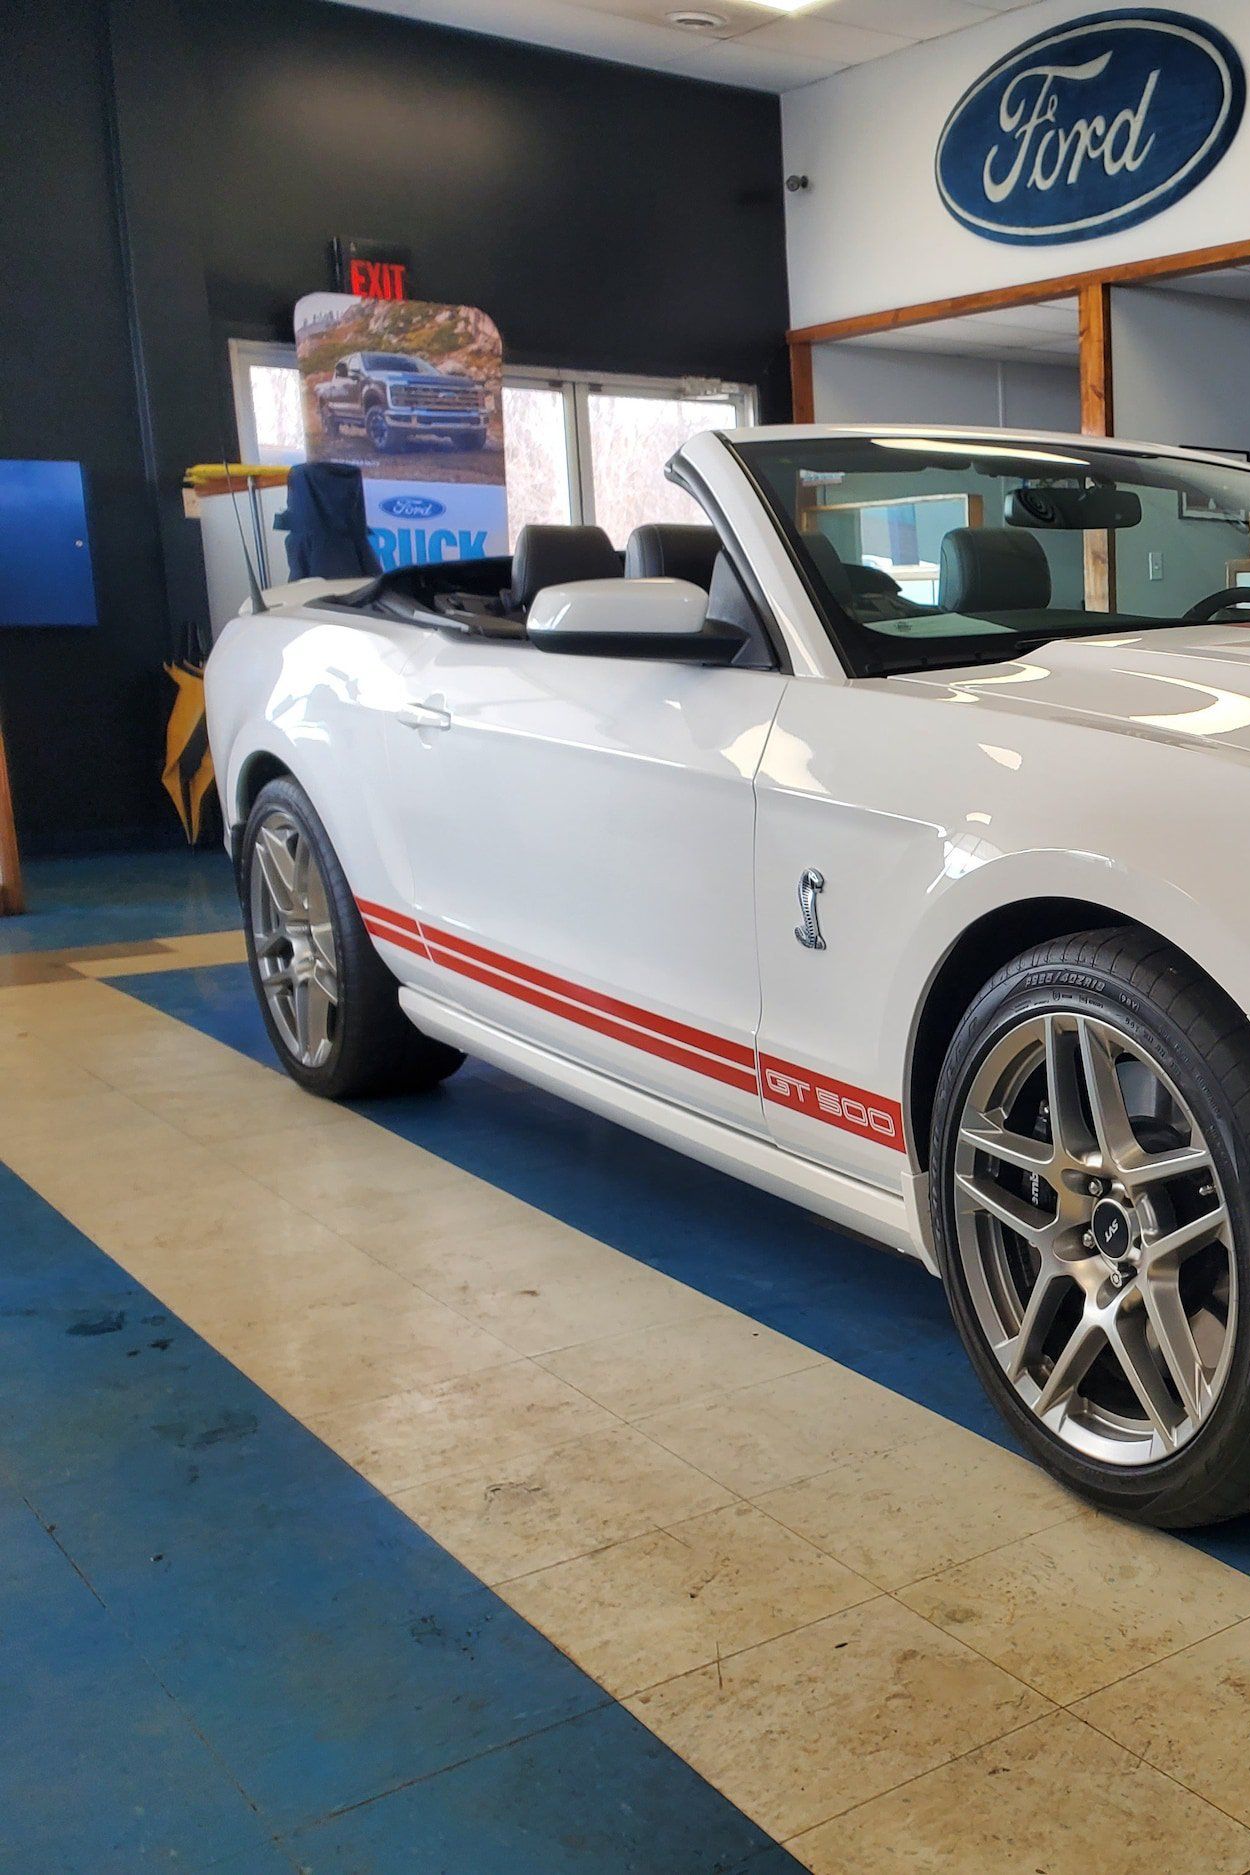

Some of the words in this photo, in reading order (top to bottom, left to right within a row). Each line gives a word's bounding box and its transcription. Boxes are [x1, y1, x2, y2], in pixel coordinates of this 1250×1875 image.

[983, 50, 1161, 203] Ford
[350, 259, 406, 302] EXIT
[393, 499, 433, 516] Ford
[367, 527, 487, 573] RUCK
[765, 1068, 811, 1103] GT
[815, 1086, 896, 1138] 500
[1104, 1218, 1119, 1243] SVT
